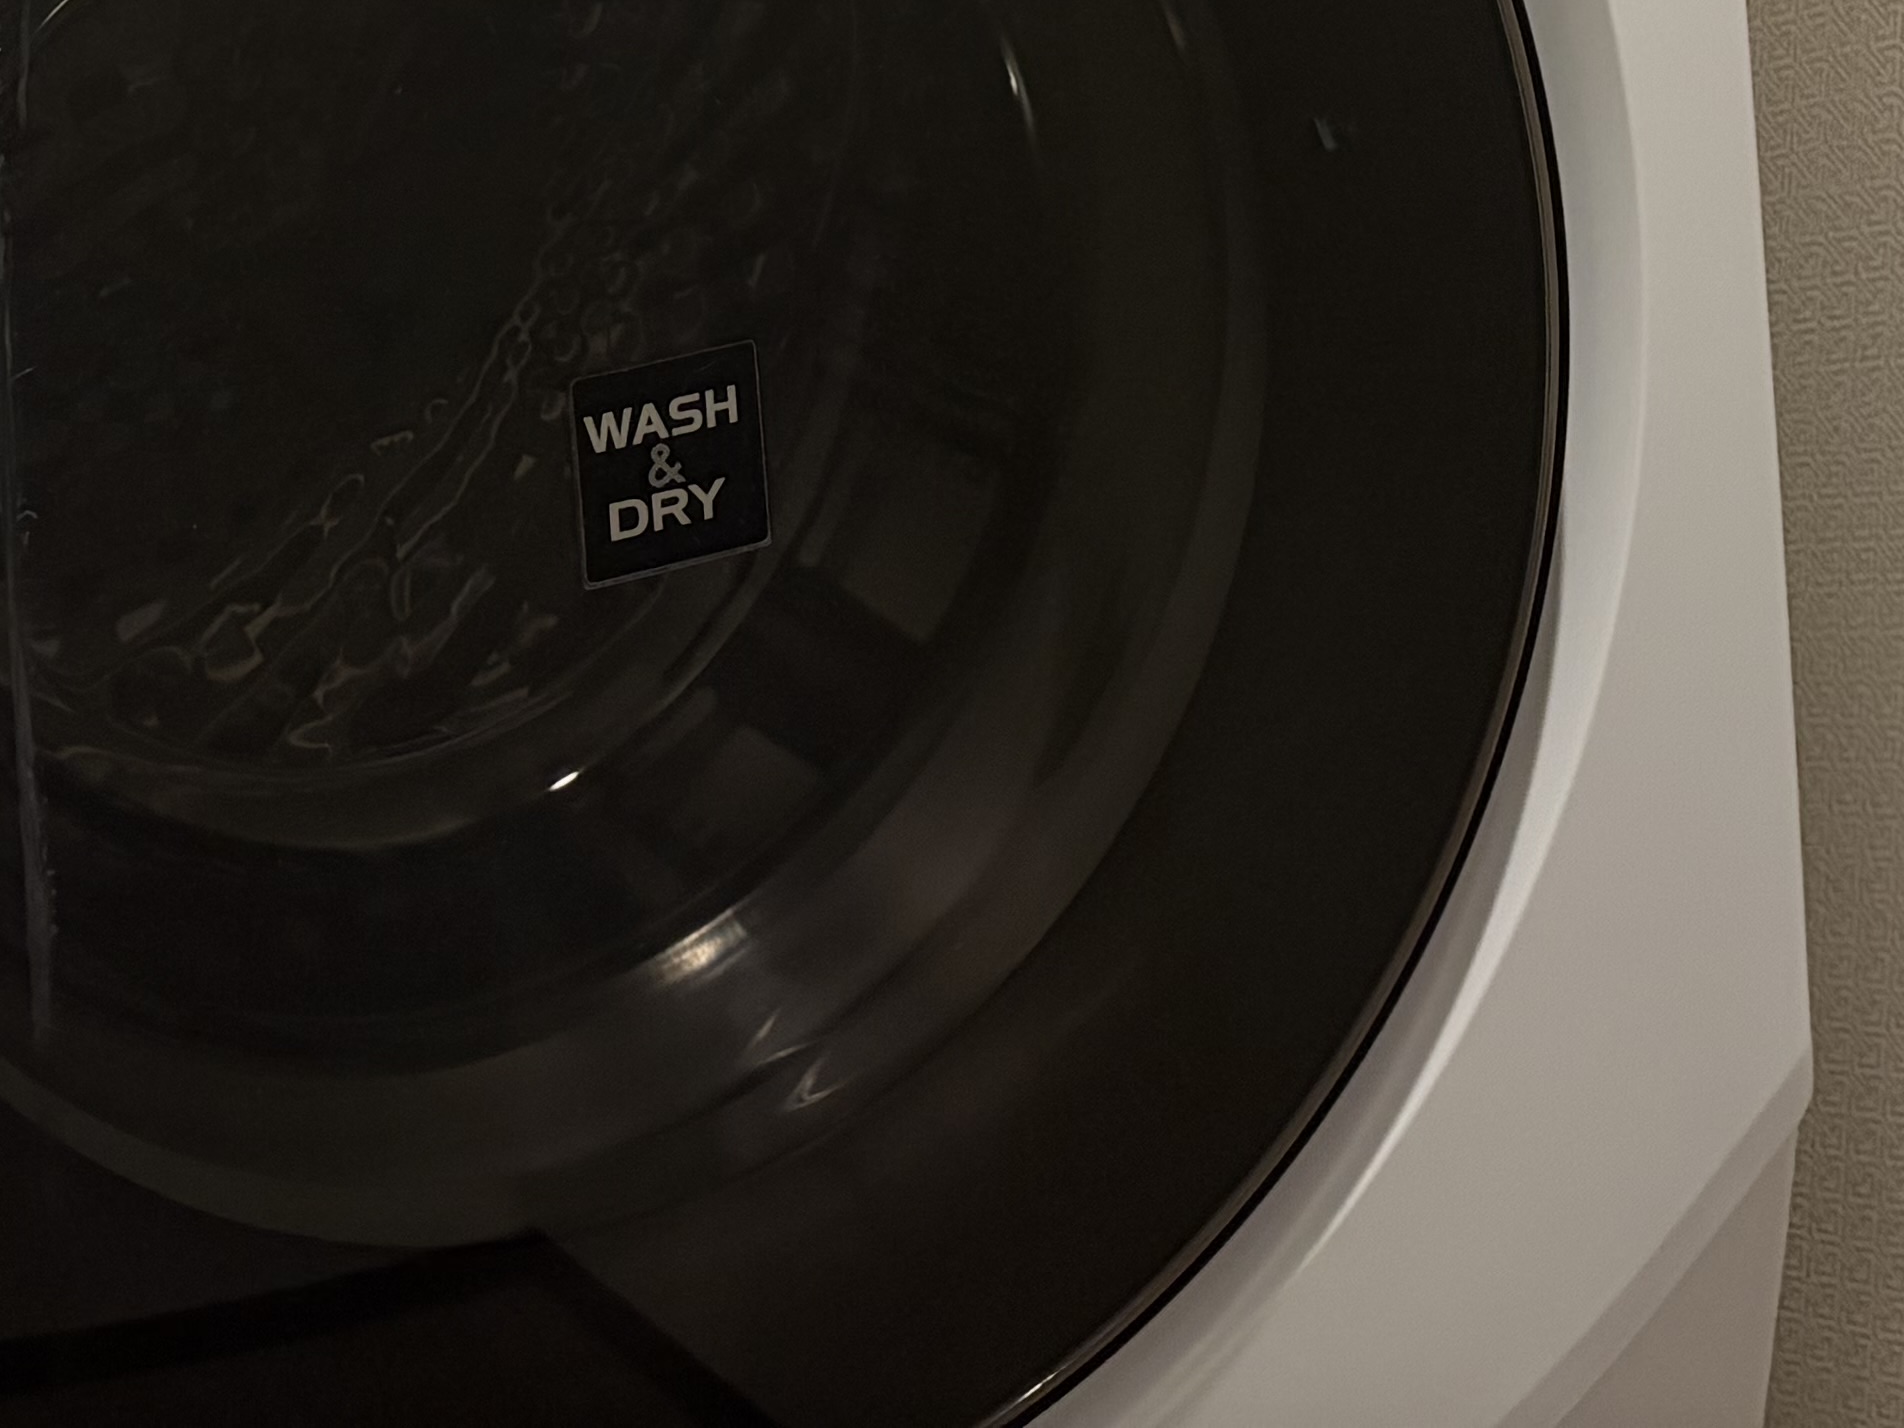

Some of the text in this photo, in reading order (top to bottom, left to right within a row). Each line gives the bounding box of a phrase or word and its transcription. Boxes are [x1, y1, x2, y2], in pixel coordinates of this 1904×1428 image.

[582, 384, 739, 454] WASH
[648, 443, 687, 489] &
[608, 476, 727, 543] DRY
